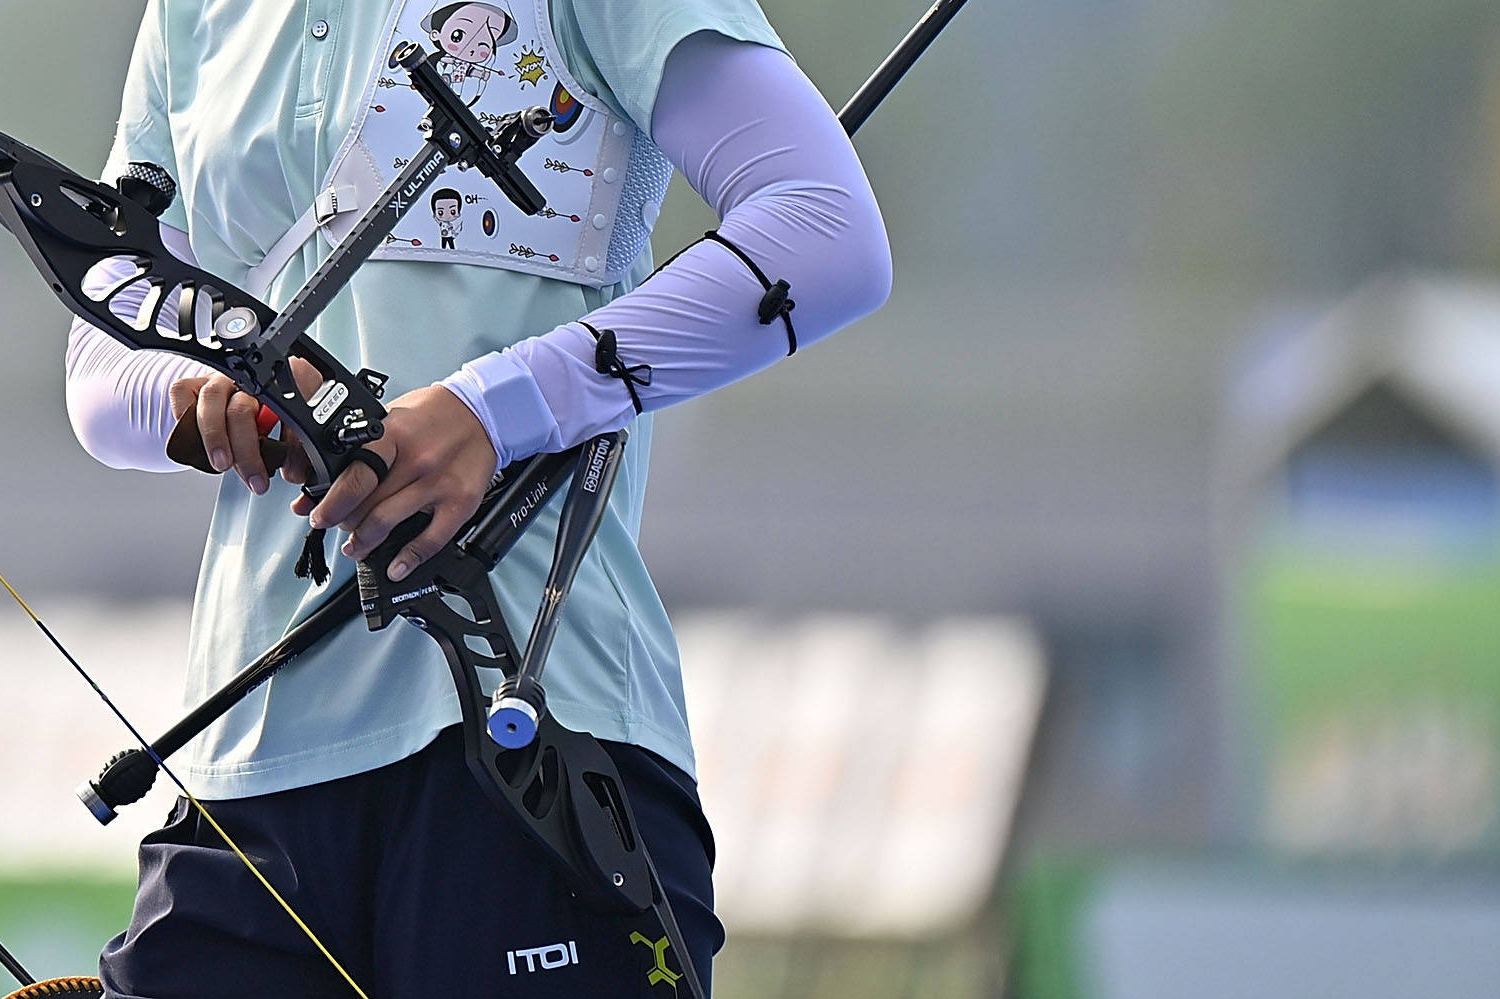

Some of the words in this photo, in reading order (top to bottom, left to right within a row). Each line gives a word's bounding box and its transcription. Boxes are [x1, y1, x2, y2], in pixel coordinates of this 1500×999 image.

[403, 150, 445, 197] ULTIMA
[317, 387, 344, 419] XCEED
[591, 438, 611, 479] EASTON
[509, 480, 548, 528] Pro-Link
[507, 940, 579, 975] ITOI
